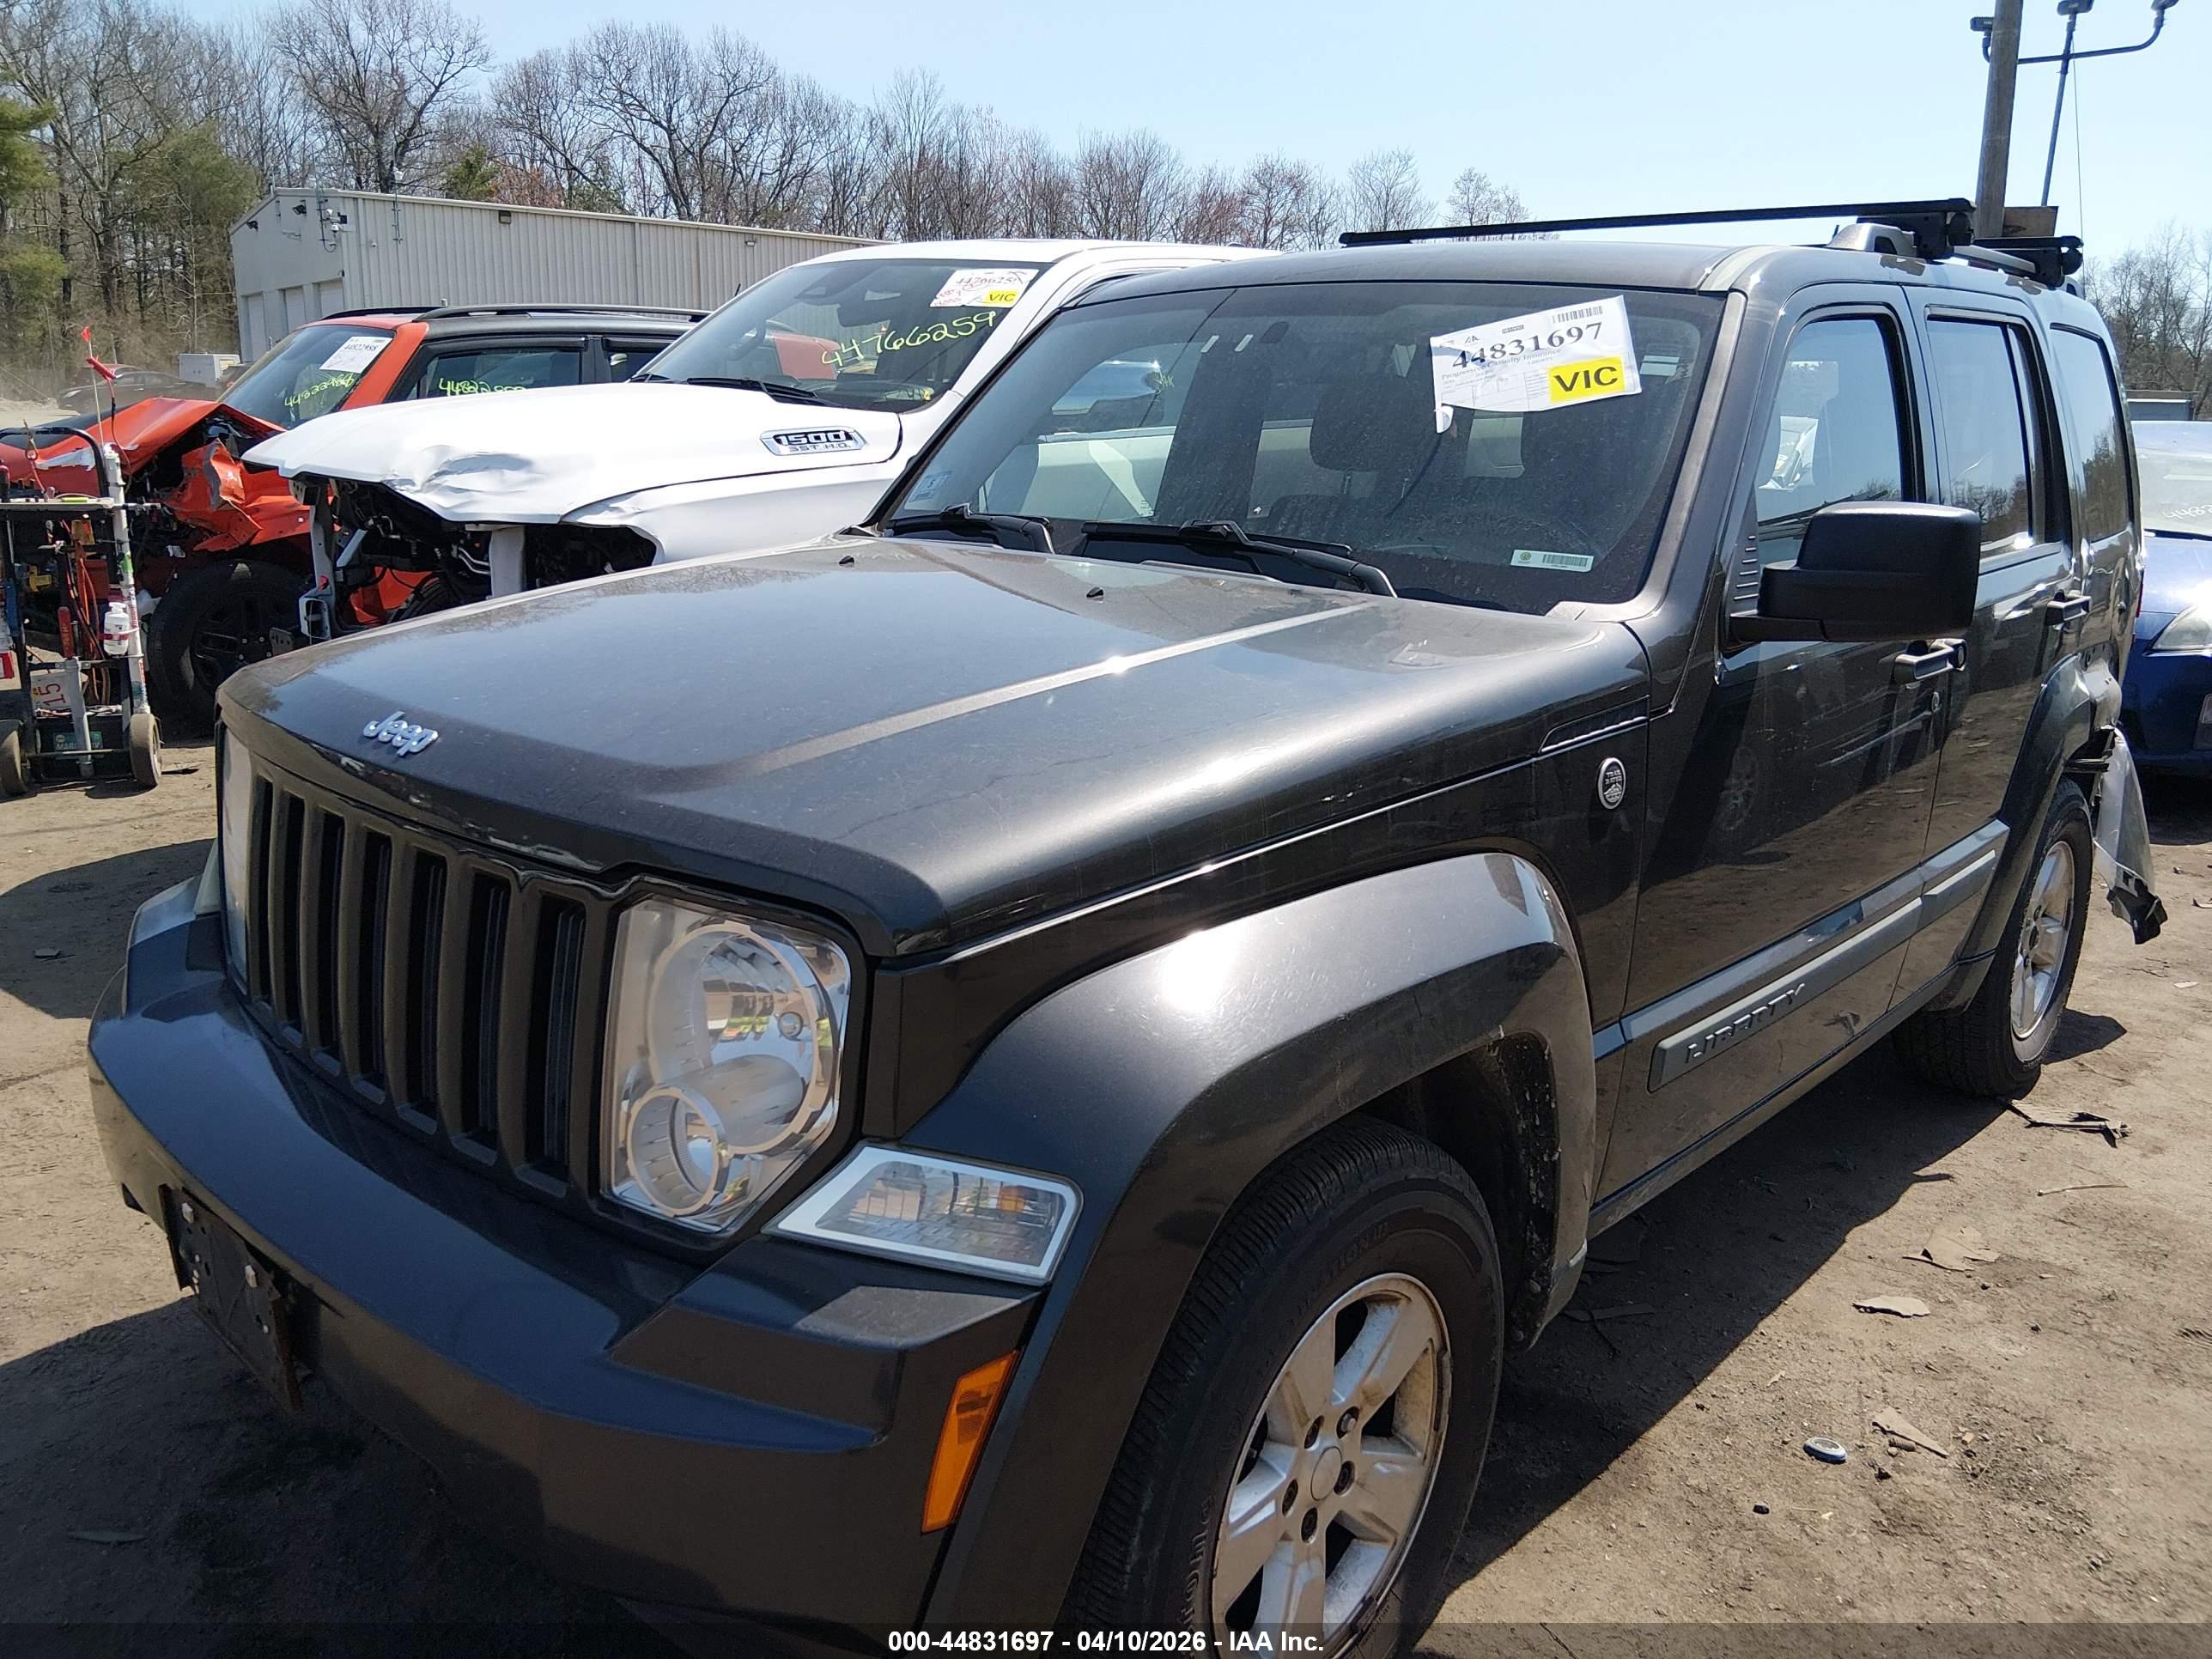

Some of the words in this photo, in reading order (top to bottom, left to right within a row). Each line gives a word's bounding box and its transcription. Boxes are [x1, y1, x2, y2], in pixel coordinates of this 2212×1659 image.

[988, 293, 1017, 302] VIC
[822, 310, 996, 367] 44766259
[1452, 321, 1603, 369] 44831697
[1553, 366, 1619, 392] VIC
[773, 429, 847, 447] 1500
[362, 711, 439, 757] Jeep
[1684, 983, 1806, 1064] LIBERTY
